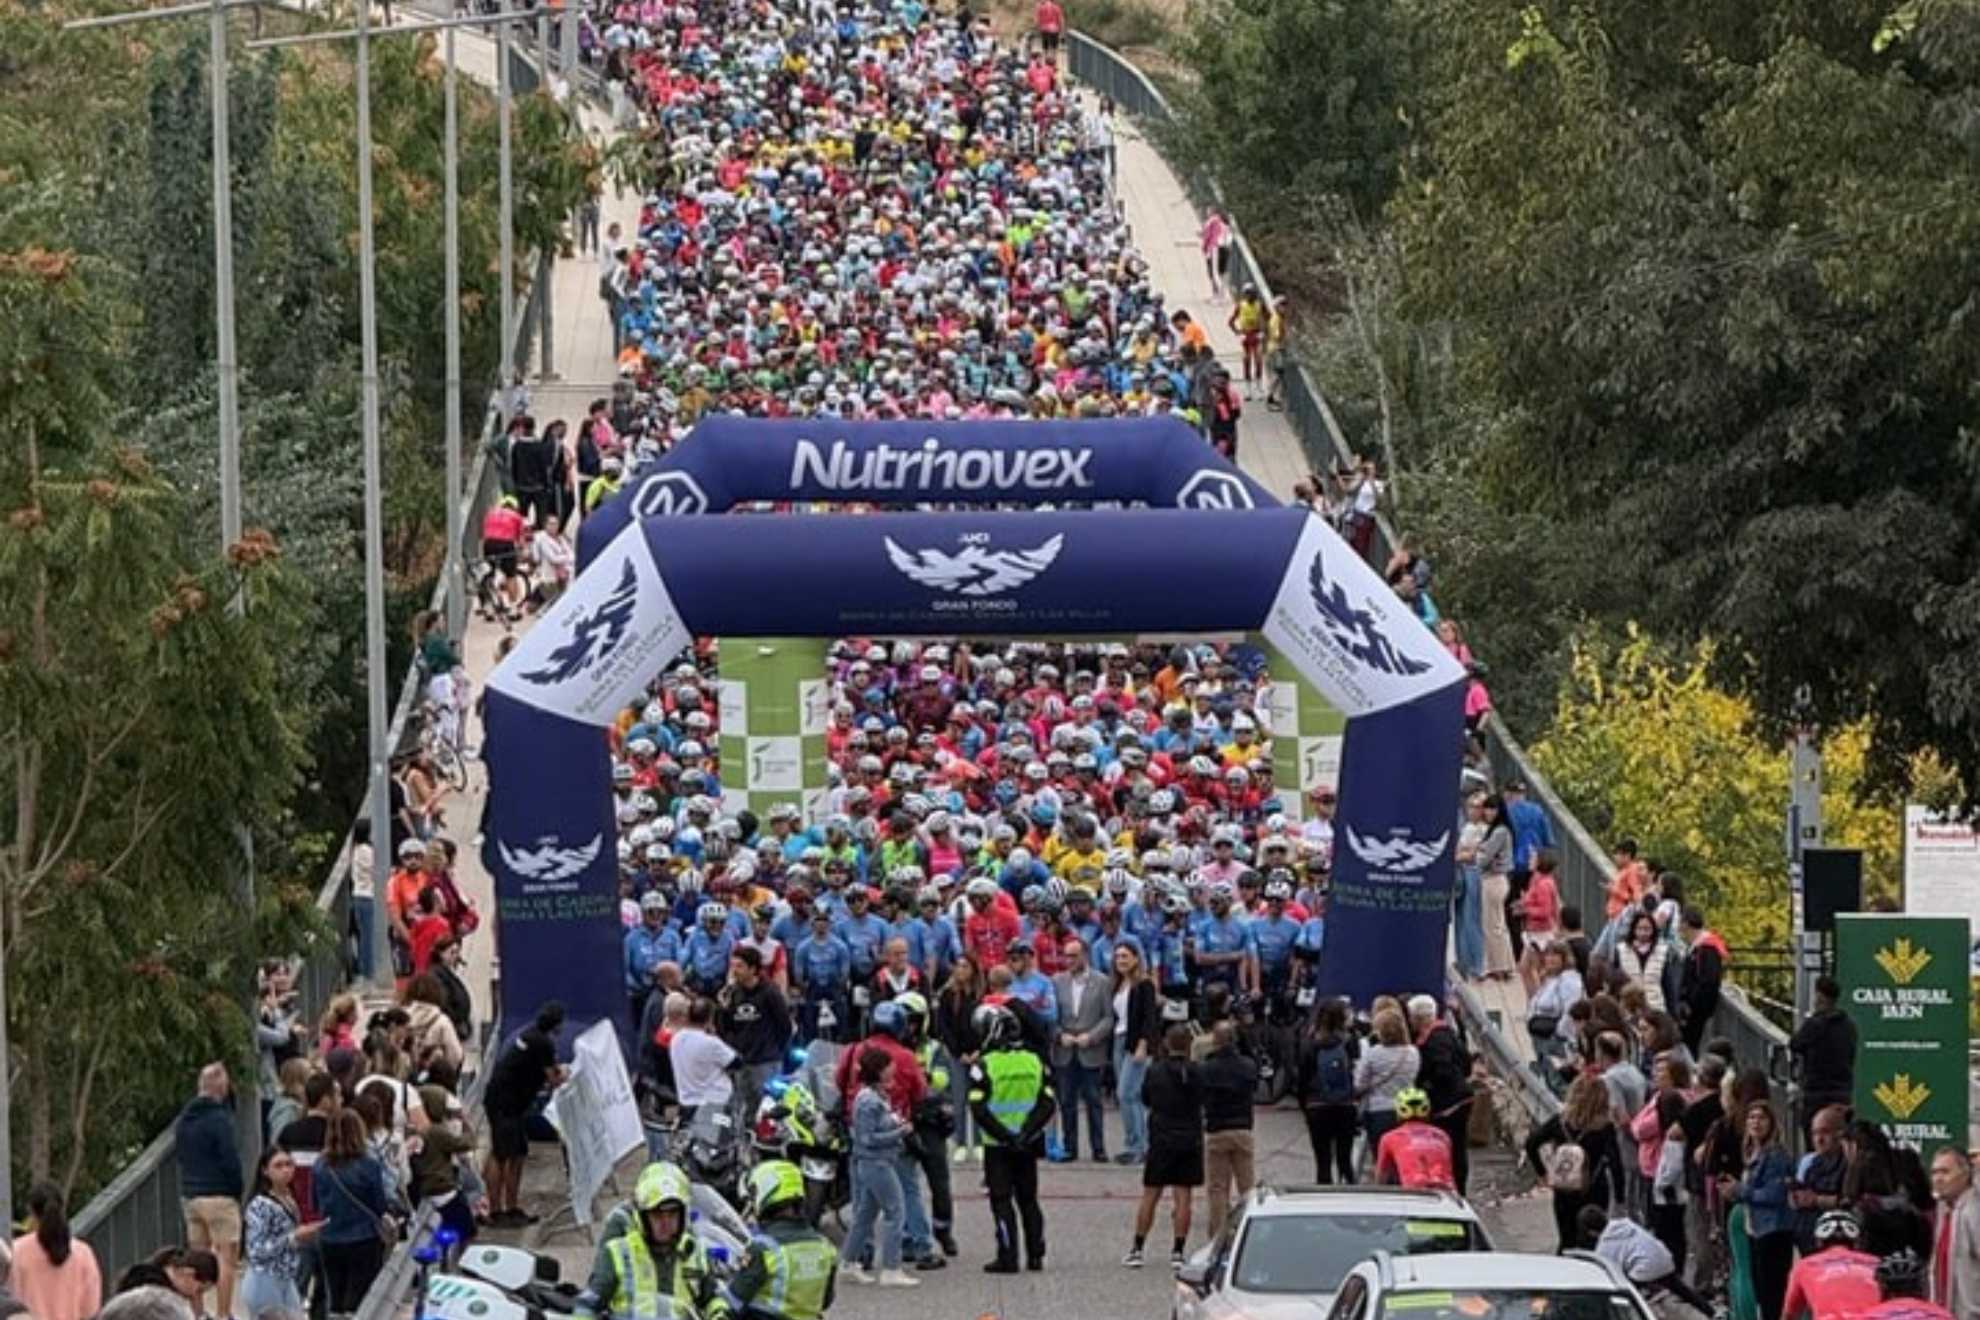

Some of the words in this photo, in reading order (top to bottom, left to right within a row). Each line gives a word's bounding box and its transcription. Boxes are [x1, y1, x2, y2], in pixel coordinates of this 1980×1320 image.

[789, 438, 1092, 490] Nutrinovex
[932, 601, 968, 611] GRAN
[971, 601, 1018, 611] FONDO
[1853, 988, 1892, 1003] CAJA
[1896, 988, 1952, 1003] RURAL
[1895, 1124, 1952, 1138] RURAL
